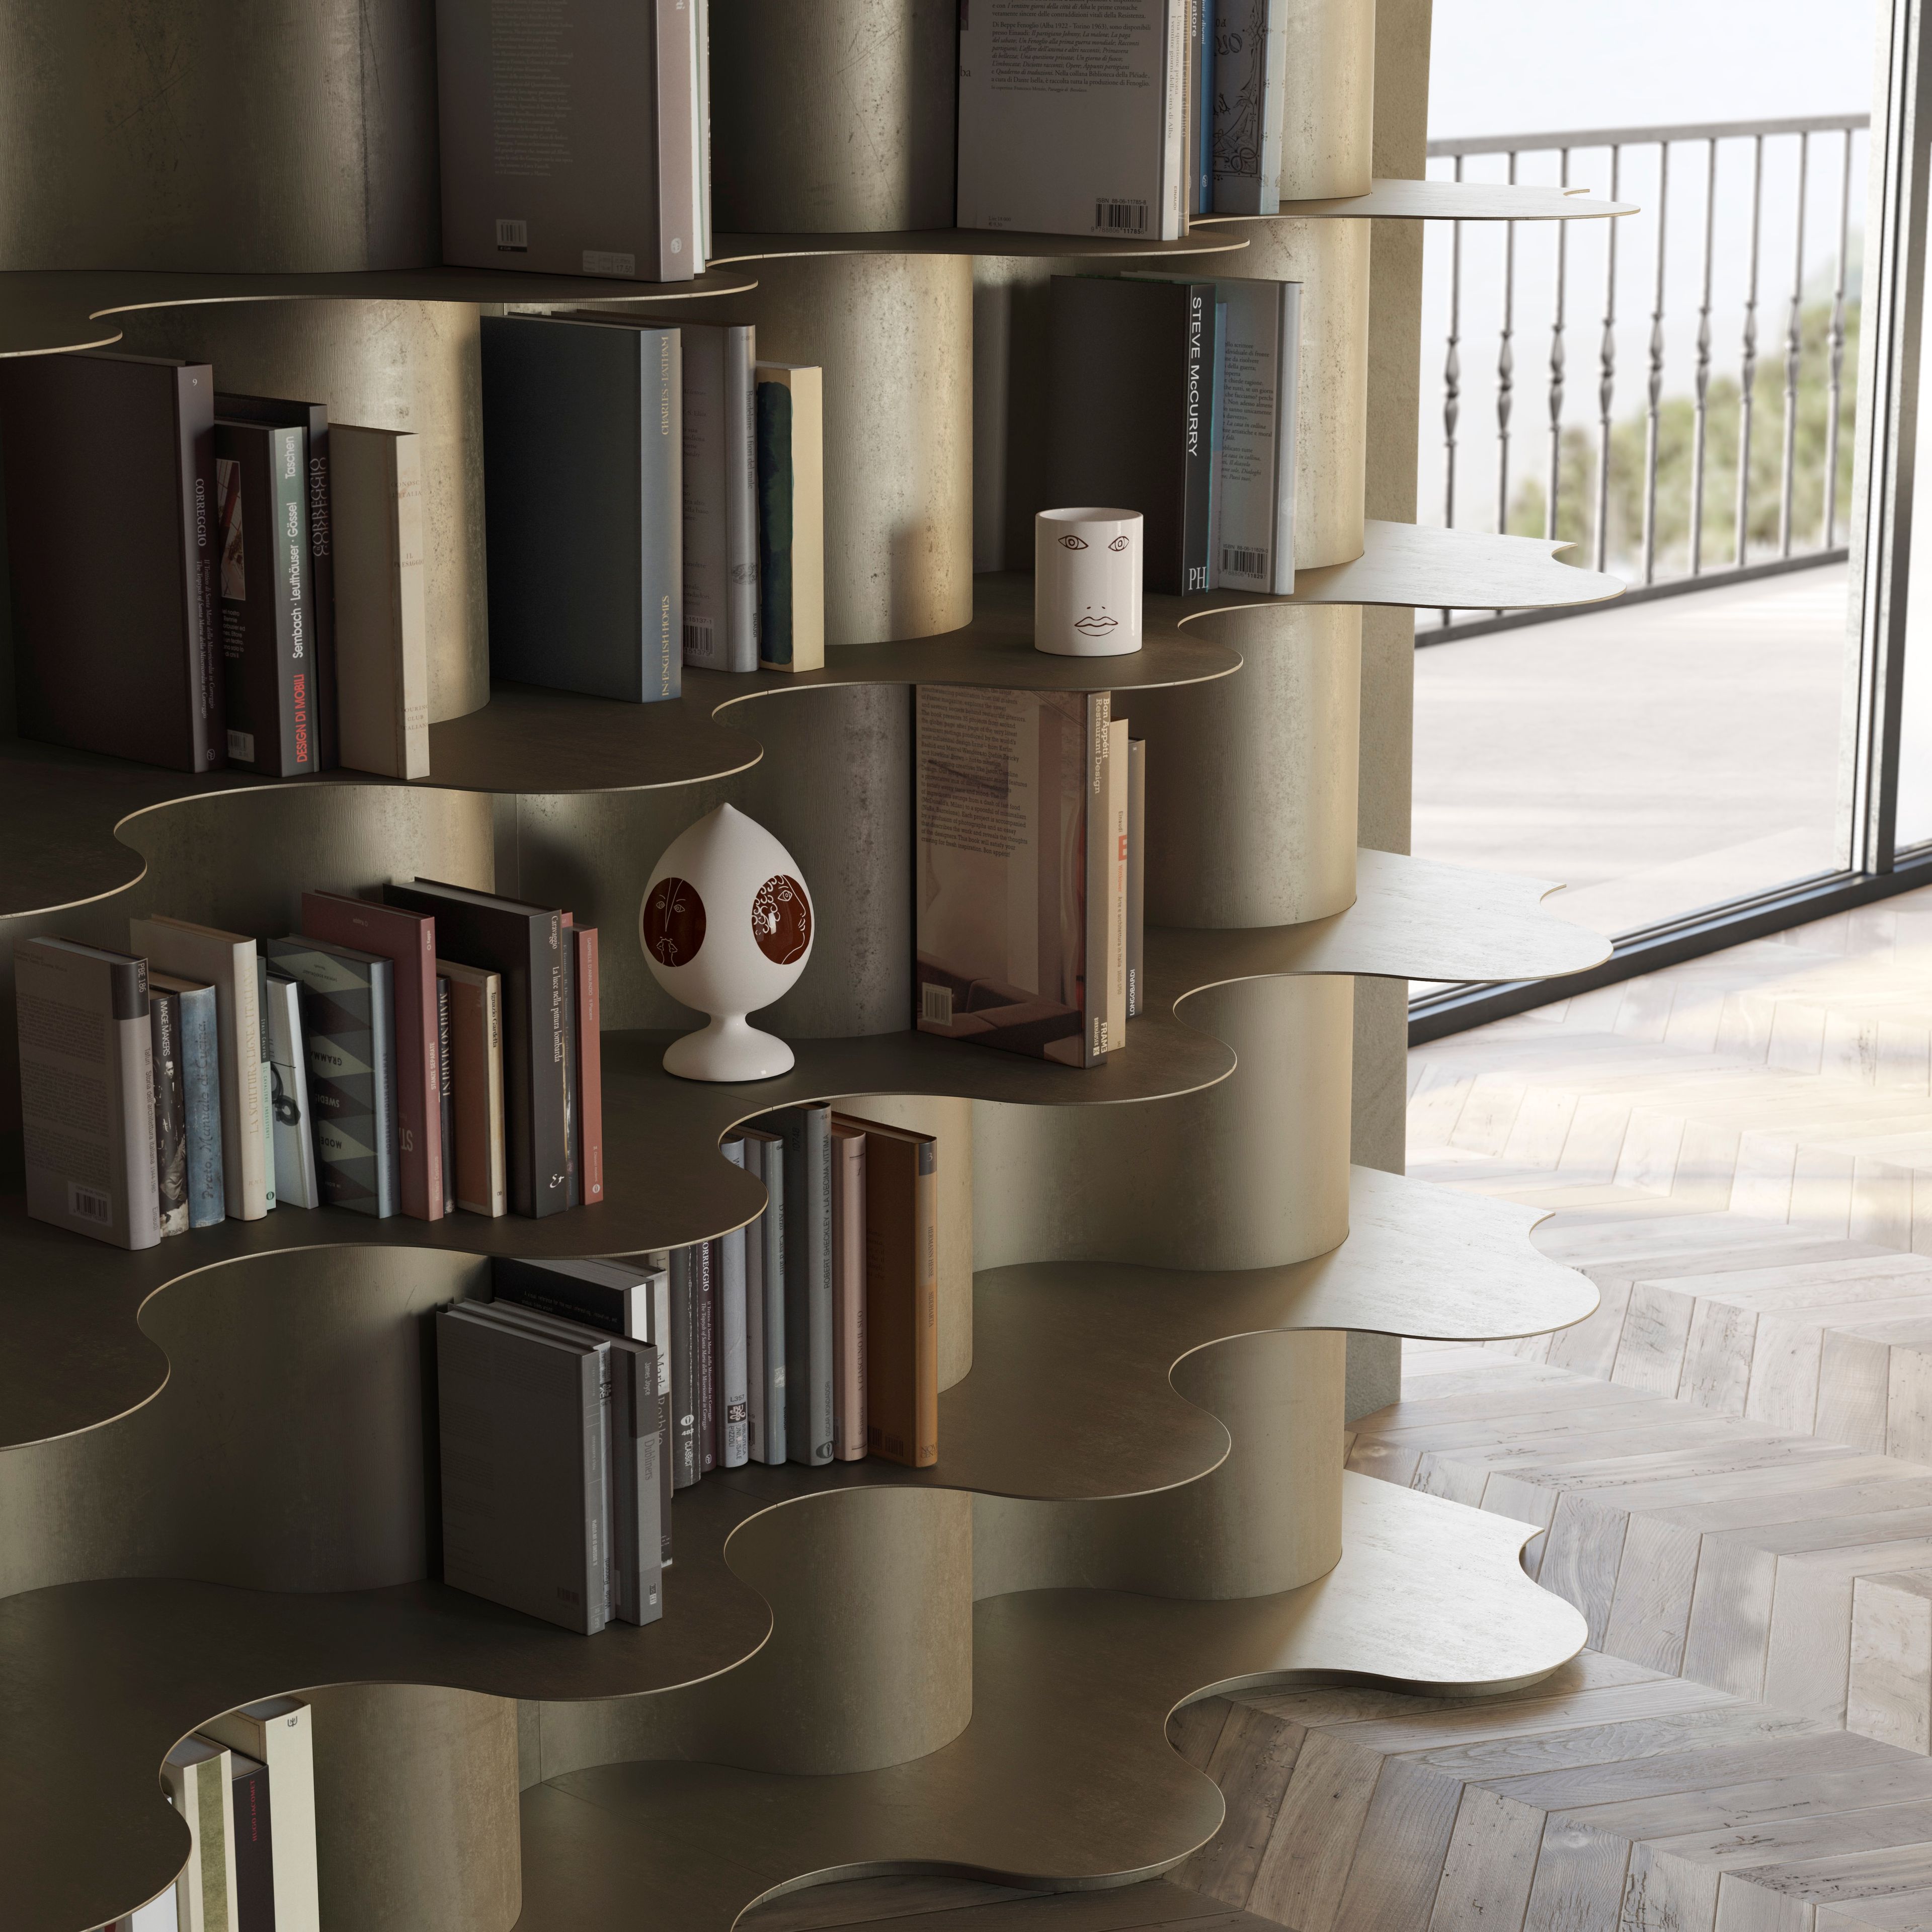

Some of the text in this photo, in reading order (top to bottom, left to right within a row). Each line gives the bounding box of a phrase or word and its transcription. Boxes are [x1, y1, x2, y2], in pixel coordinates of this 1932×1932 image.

[1188, 297, 1201, 456] STEVE McCURRY
[661, 388, 669, 436] CHARLES
[746, 390, 755, 431] Baudelaire
[748, 472, 756, 491] male
[196, 479, 207, 547] CORREGGIO
[284, 436, 303, 659] Sembach Leuthäuser Gössel Taschen
[196, 574, 204, 594] Triptych
[294, 674, 308, 763] DESIGN DI MOBILI
[1101, 720, 1110, 759] Appétit
[1093, 698, 1103, 794] Restaurant Design
[138, 962, 146, 993] PBE 186
[549, 915, 563, 1063] Caravaggio La luce nella pittura lombarda
[160, 1000, 171, 1057] IMAGE MAKERS
[244, 966, 259, 1135] LA SCULTURA LIGNEA ITALIANA
[440, 992, 451, 1096] MARINO MARINI
[198, 1071, 208, 1088] di
[147, 1091, 155, 1140] dell'architettura
[199, 1091, 213, 1153] Manuale
[926, 1152, 933, 1162] 3
[823, 1197, 830, 1208] LA
[730, 1394, 745, 1402] L357
[644, 1438, 655, 1481] Dubliners
